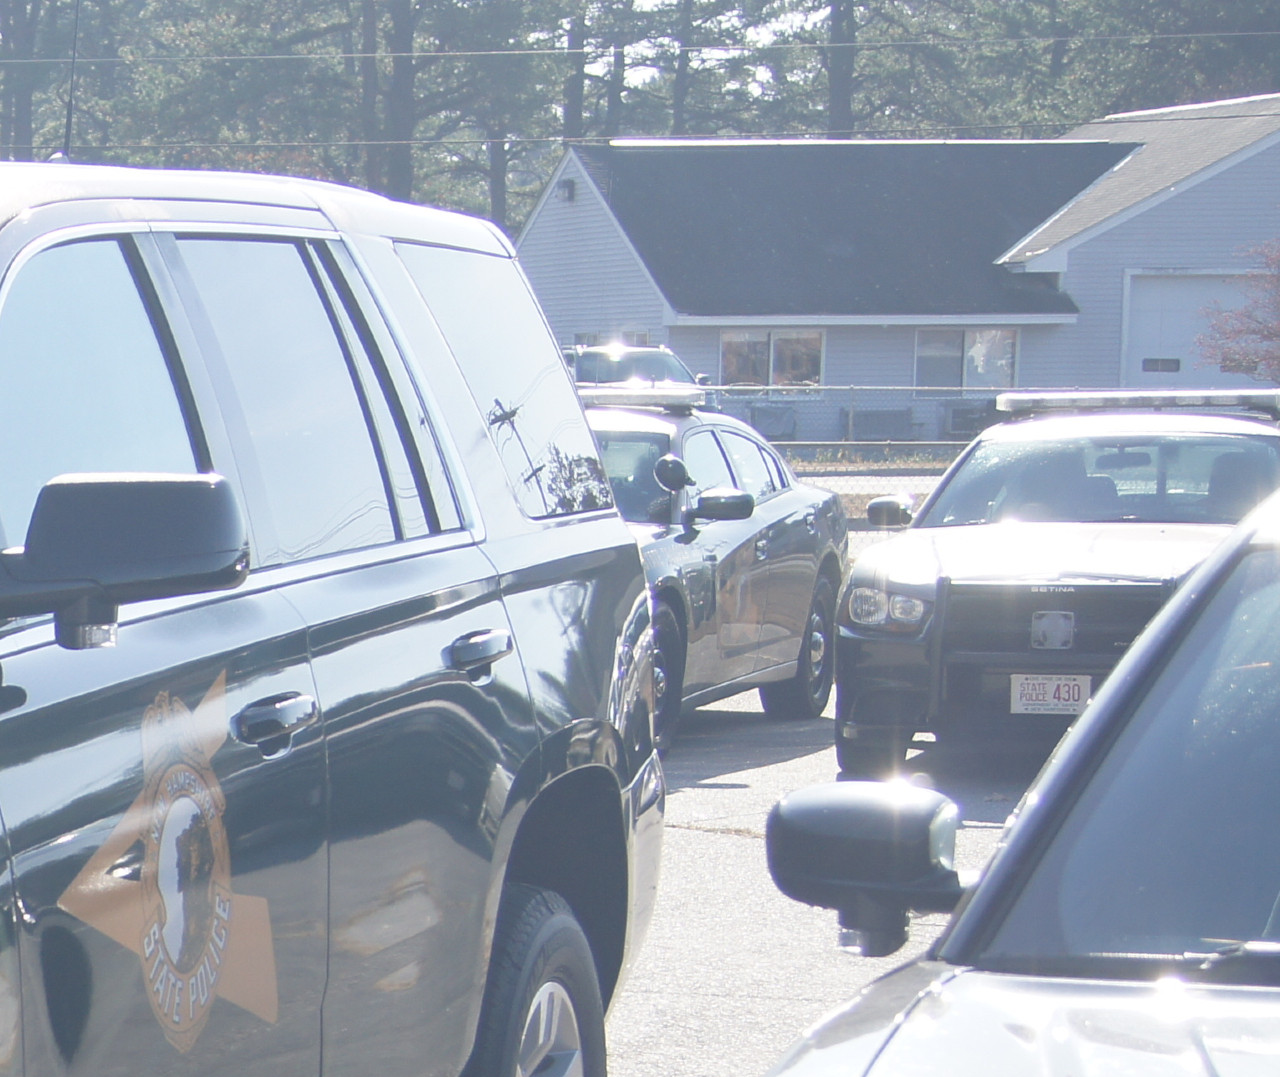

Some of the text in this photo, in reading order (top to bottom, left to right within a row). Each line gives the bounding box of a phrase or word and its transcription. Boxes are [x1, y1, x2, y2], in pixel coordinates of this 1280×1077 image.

[1020, 682, 1048, 692] STATE
[1053, 683, 1081, 702] 430
[1020, 692, 1048, 702] POLICE
[143, 895, 230, 1023] STATE POLICE
